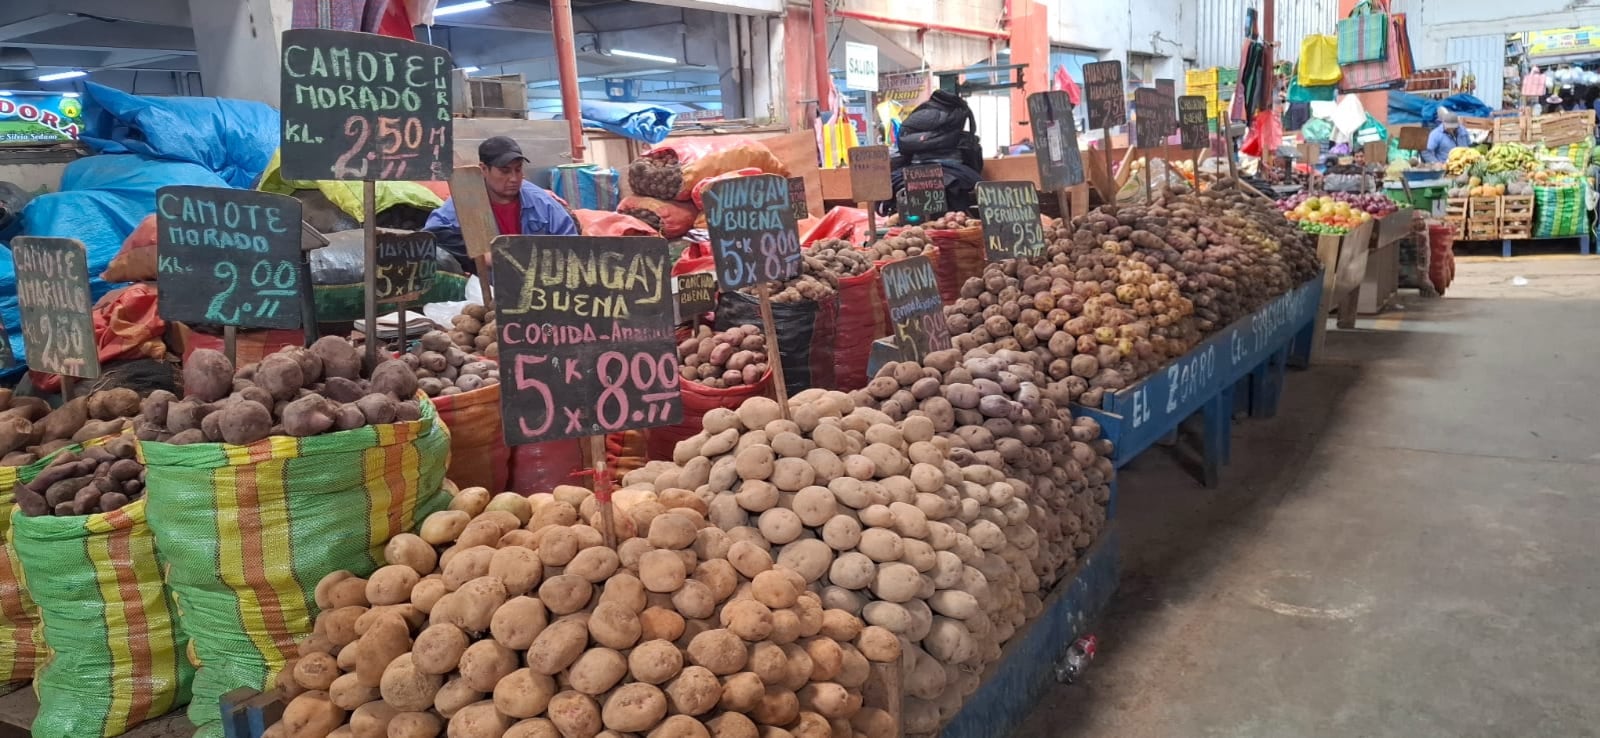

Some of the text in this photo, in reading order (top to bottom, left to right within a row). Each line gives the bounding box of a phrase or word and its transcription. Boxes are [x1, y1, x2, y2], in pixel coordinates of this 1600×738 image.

[284, 45, 430, 87] CAMOTE
[848, 57, 876, 76] SALIDA
[295, 84, 422, 112] MORADO
[434, 56, 451, 122] PURA
[285, 115, 424, 180] KL. 2.50
[158, 193, 288, 232] CAMOTE
[708, 177, 790, 227] YUNGAY
[725, 210, 784, 231] BUENA
[984, 206, 1036, 225] PERUANA
[168, 226, 269, 253] MORADO
[989, 223, 1045, 258] KL. 2.50
[205, 260, 297, 324] 2.00
[499, 243, 664, 314] YUNGAY
[680, 289, 710, 304] BUENA
[882, 262, 938, 299] MARIVA
[530, 287, 630, 319] BUENA
[1132, 385, 1150, 428] EL
[1166, 344, 1215, 414] ZORRO
